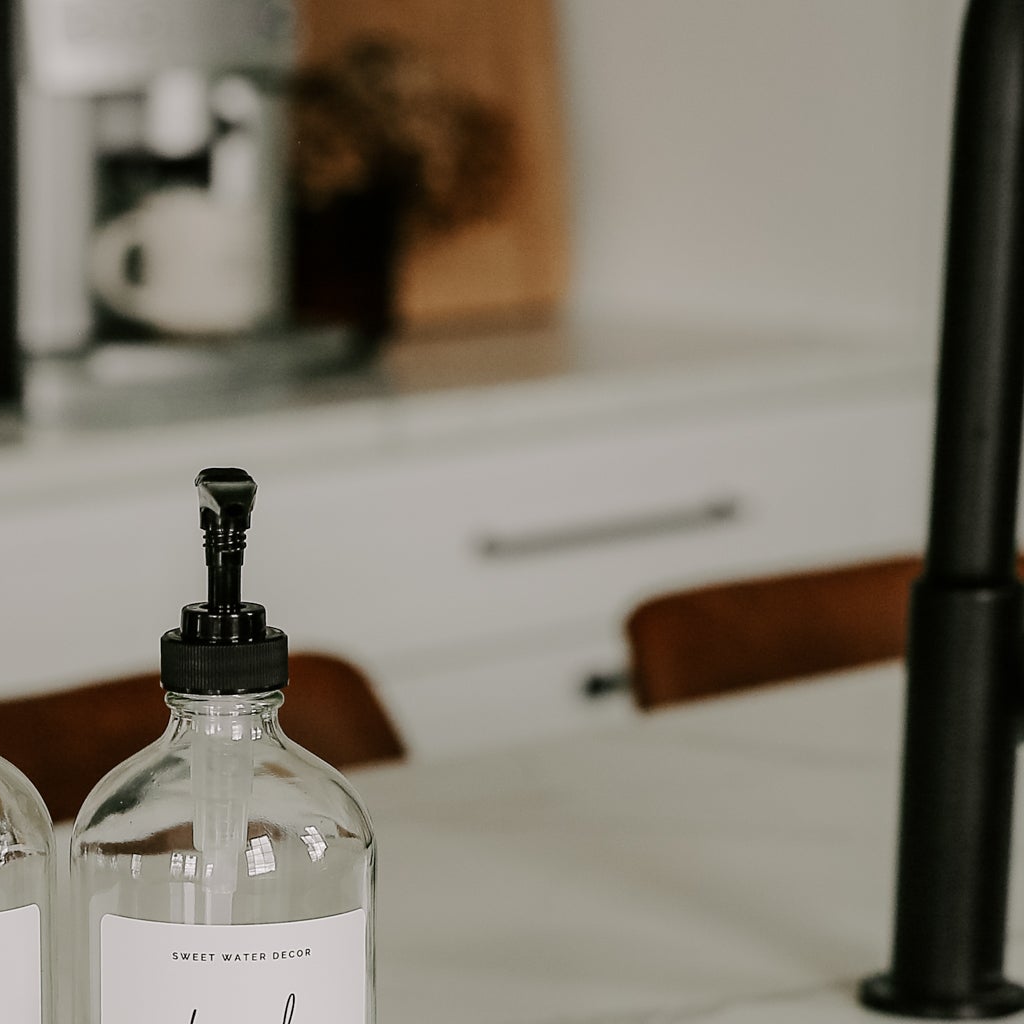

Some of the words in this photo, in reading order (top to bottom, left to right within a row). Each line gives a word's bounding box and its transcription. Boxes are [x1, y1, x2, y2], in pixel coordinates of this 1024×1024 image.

[172, 951, 216, 962] SWEET
[221, 952, 266, 962] WATER
[272, 948, 311, 960] DECOR
